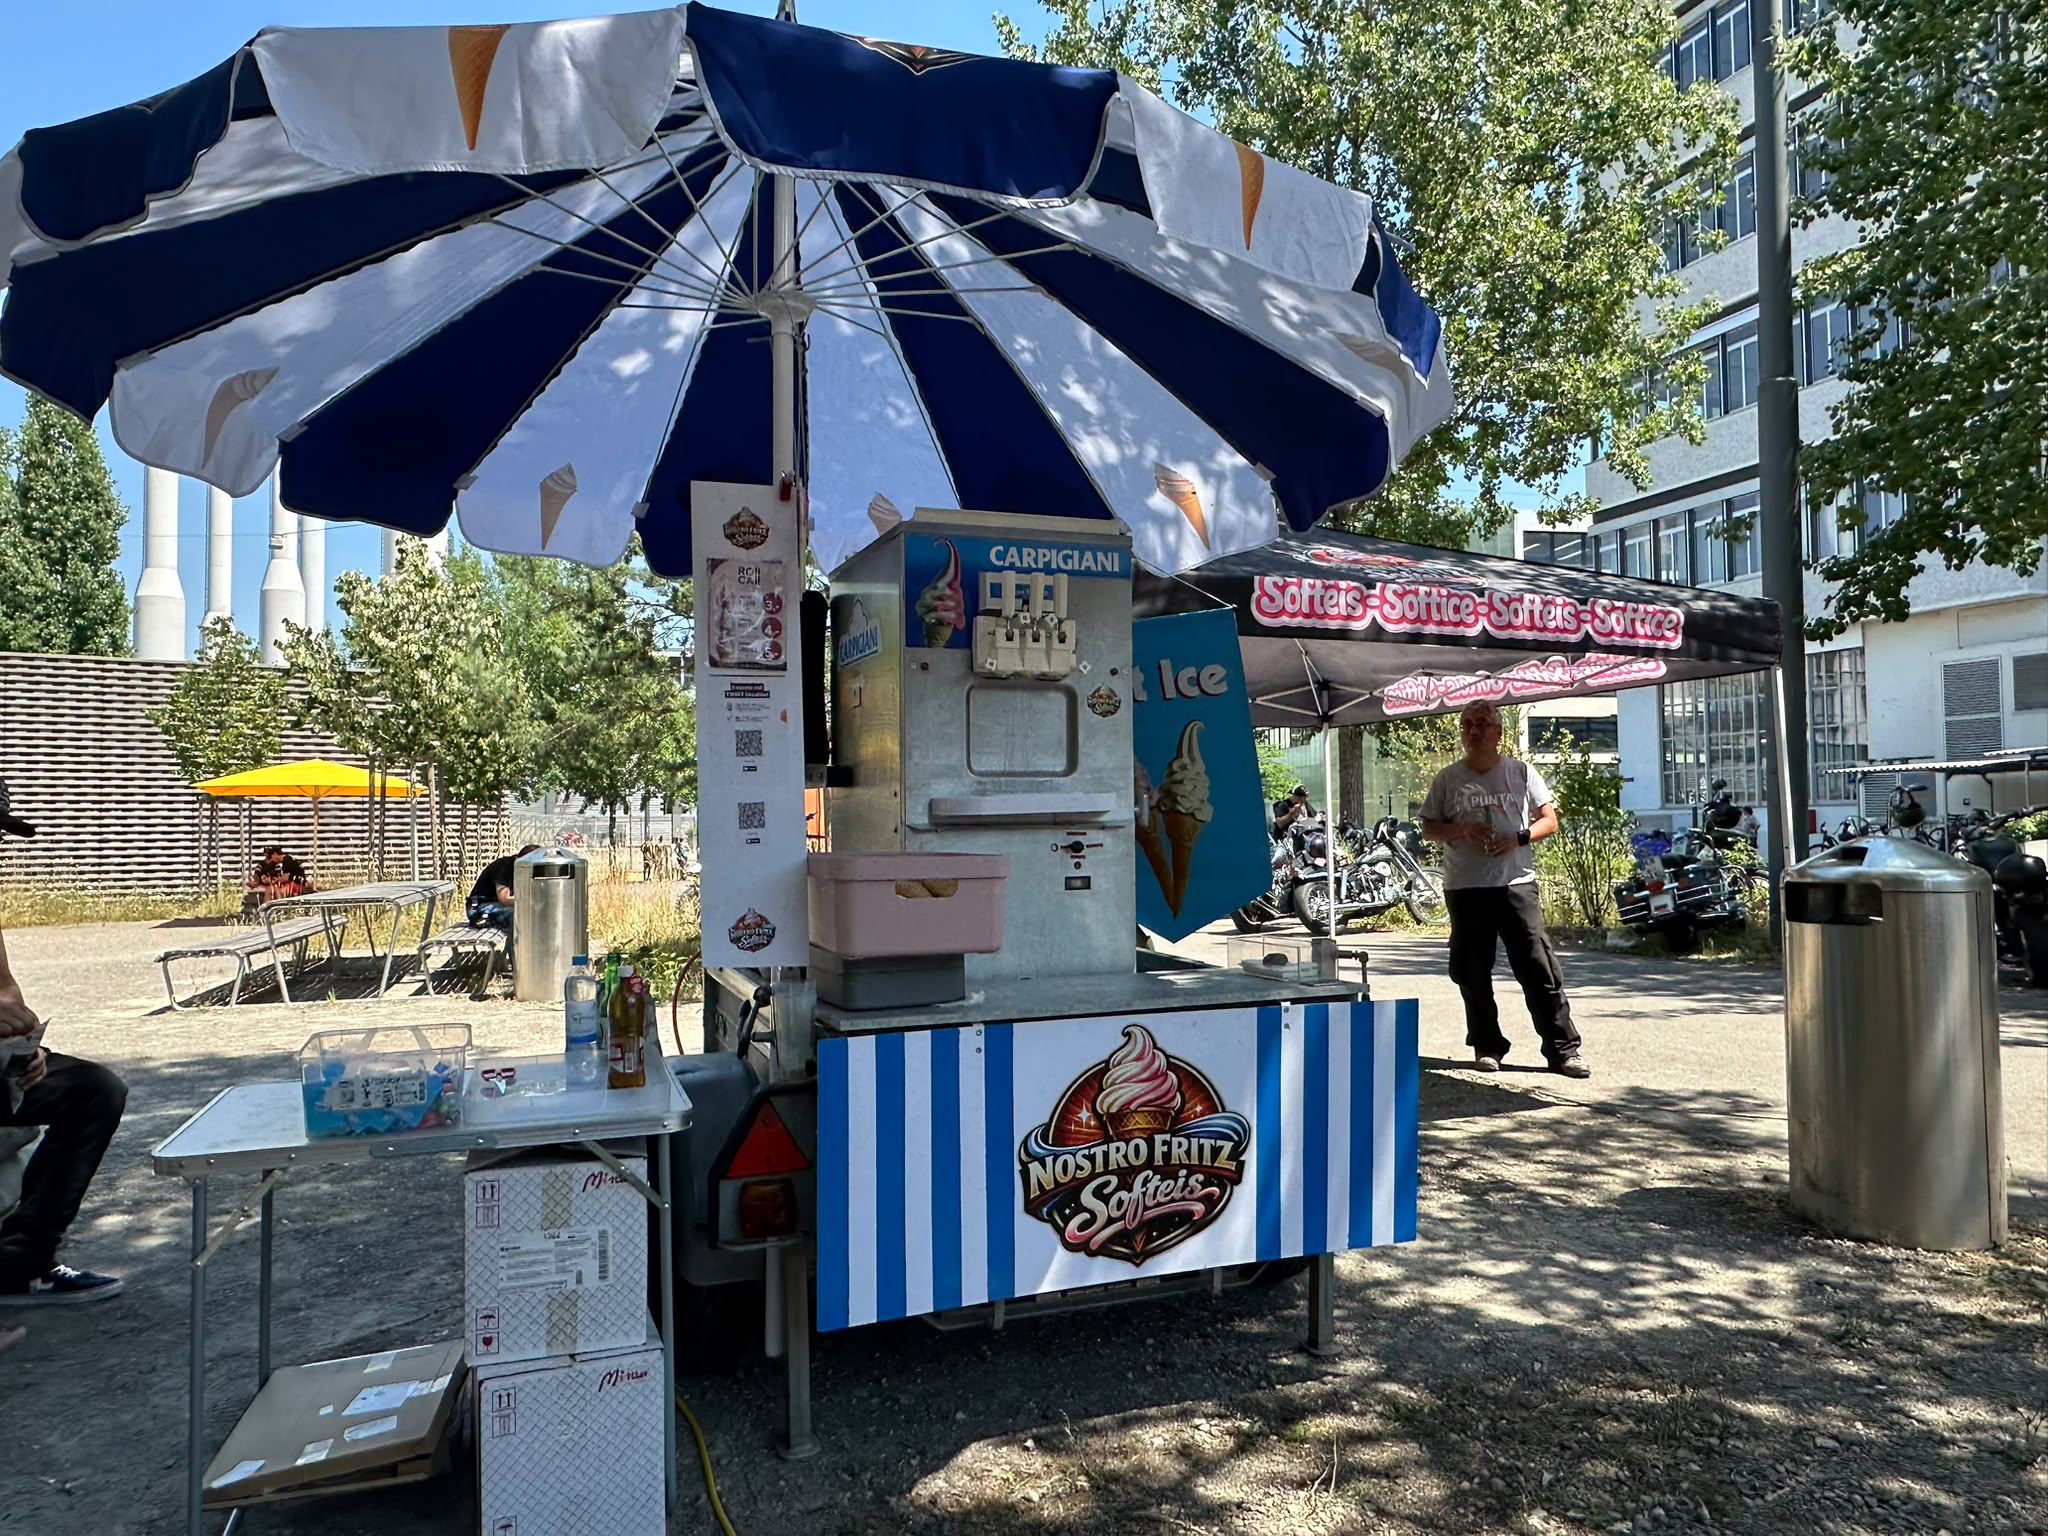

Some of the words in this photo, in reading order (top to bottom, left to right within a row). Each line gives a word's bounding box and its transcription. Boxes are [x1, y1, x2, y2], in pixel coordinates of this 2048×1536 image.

[989, 545, 1120, 573] CARPIGIANI
[840, 624, 879, 663] CARPIGIANI
[1158, 658, 1228, 699] Ice
[1028, 1138, 1148, 1199] NOSTRO
[1153, 1133, 1238, 1171] FRITZ
[1065, 1169, 1220, 1246] Softeis
